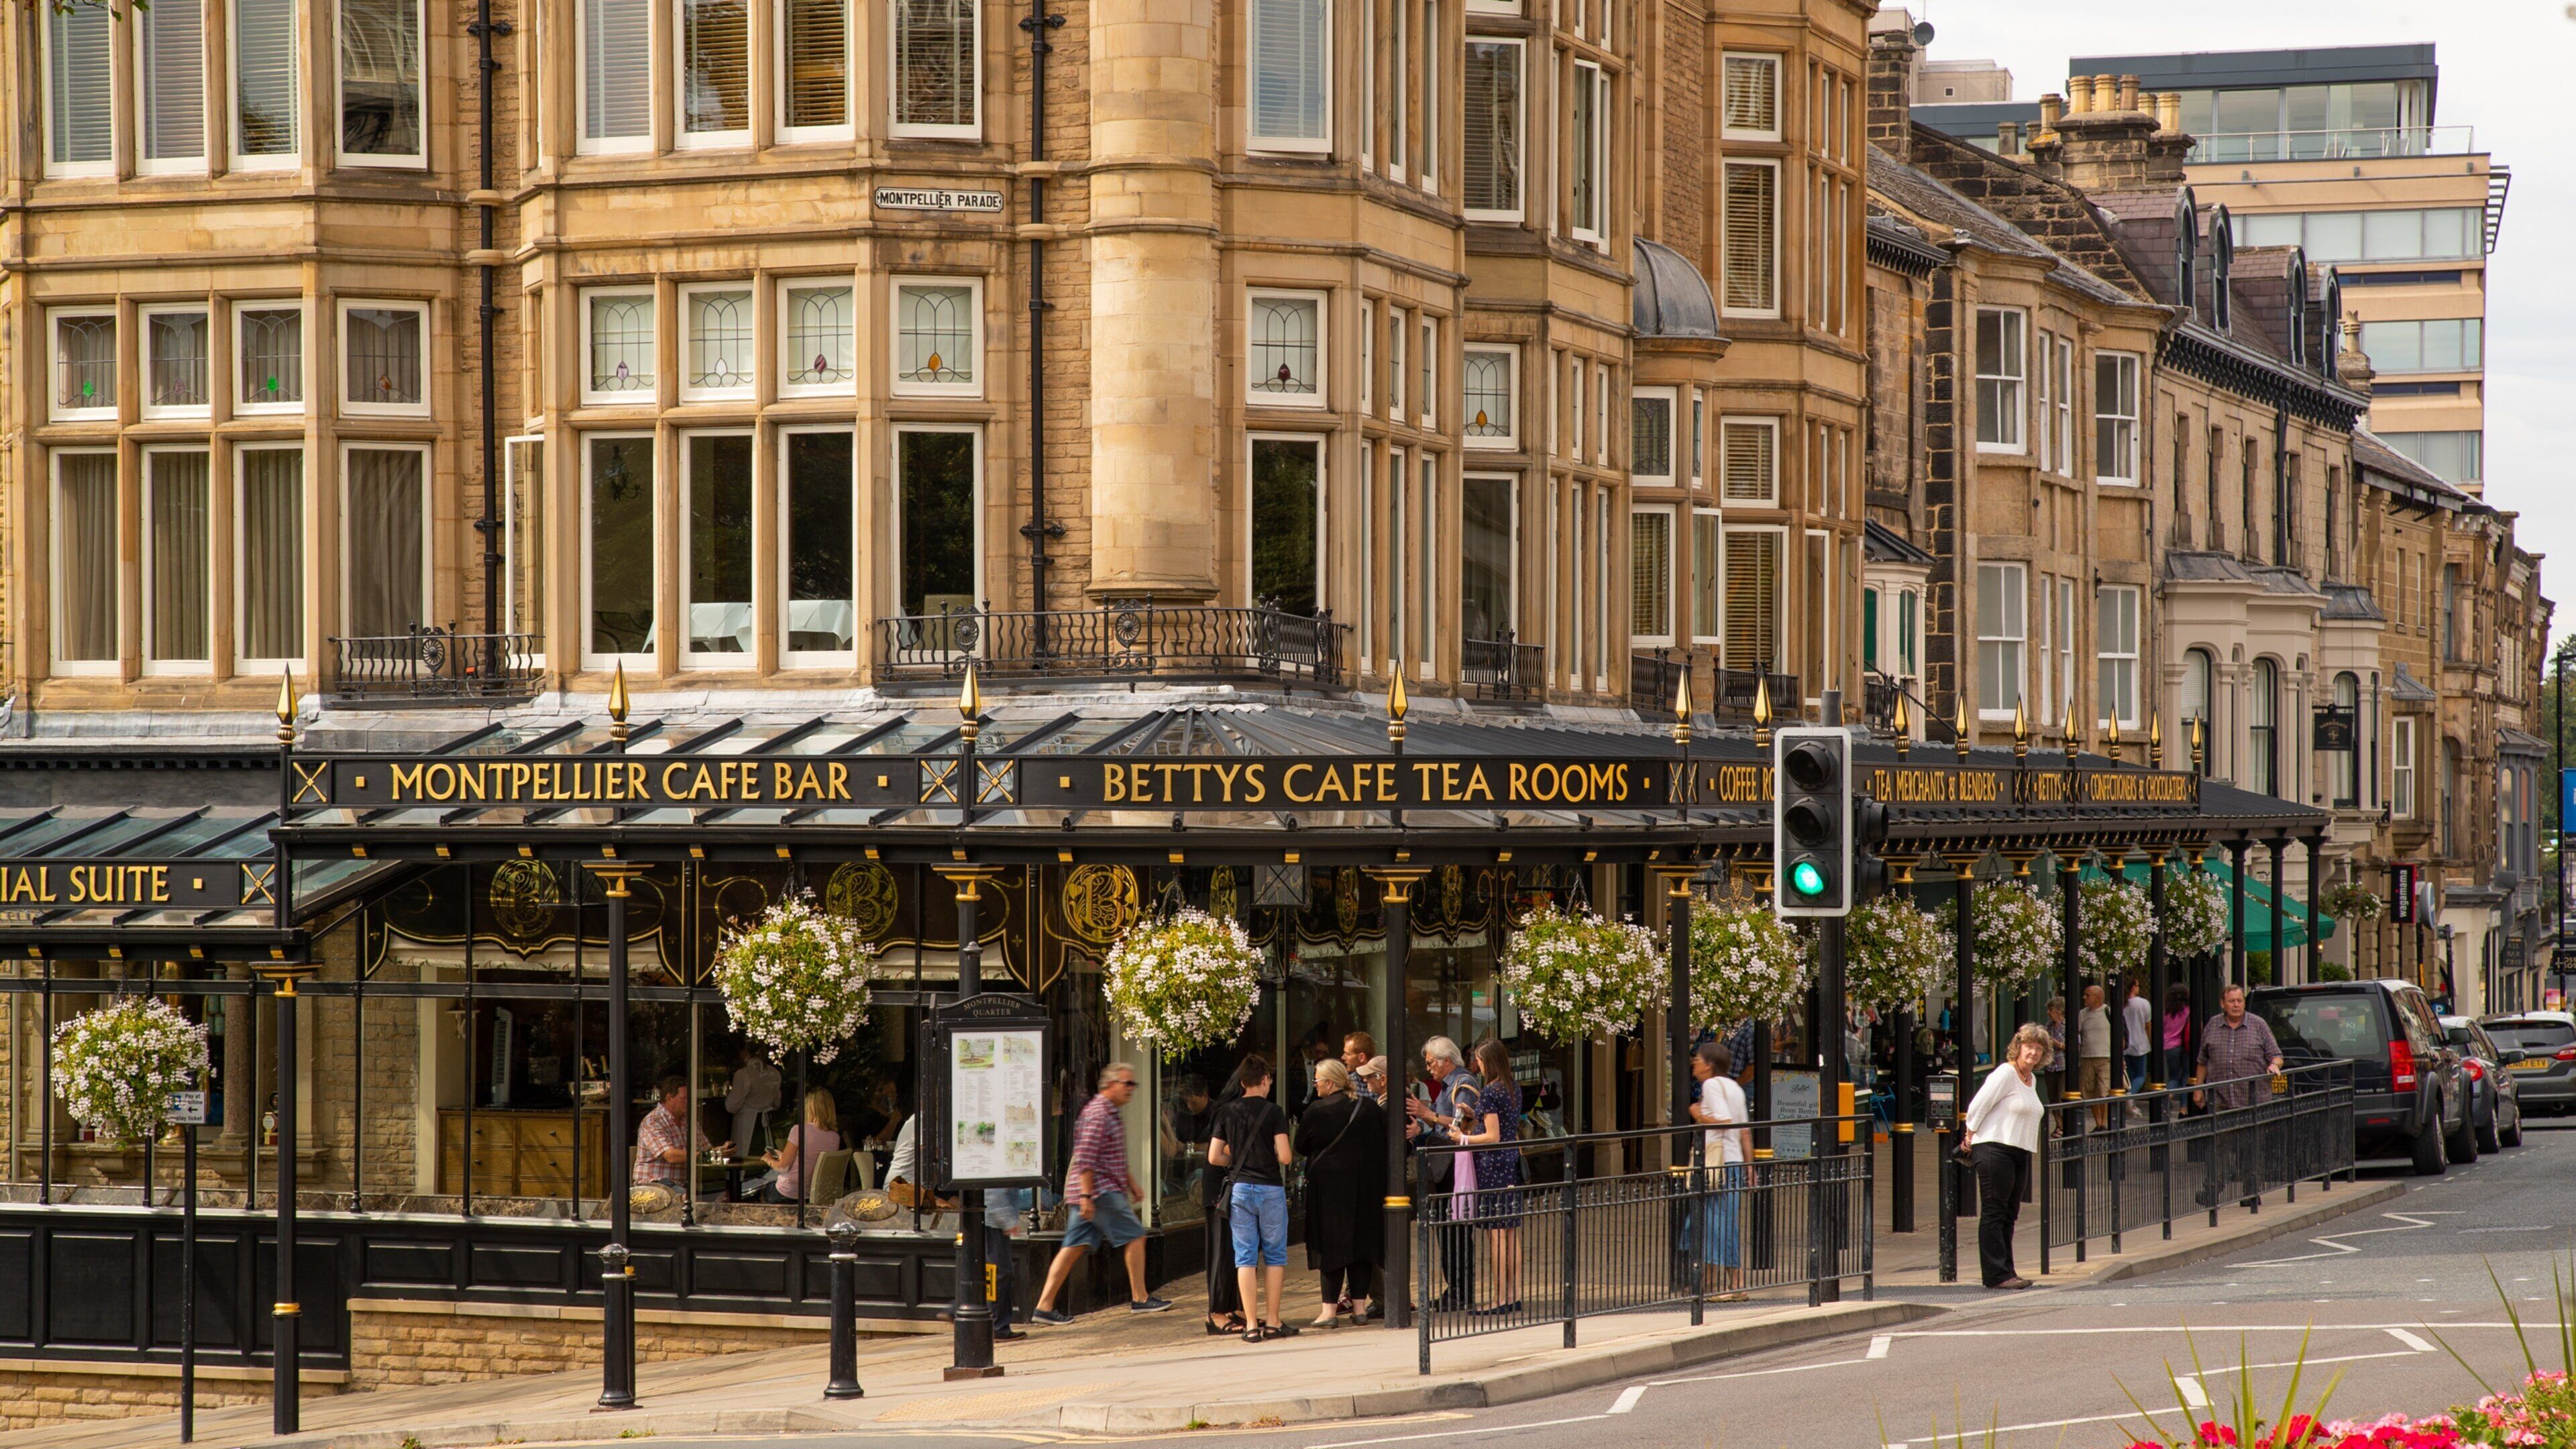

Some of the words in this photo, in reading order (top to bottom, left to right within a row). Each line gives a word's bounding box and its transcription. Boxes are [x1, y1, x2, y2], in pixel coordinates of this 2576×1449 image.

[879, 192, 951, 206] MONTPELLIER
[958, 194, 999, 207] PARADE
[391, 763, 650, 800] MONTPELLIER
[663, 762, 760, 799] CAFE
[774, 763, 851, 799] BAR
[1104, 764, 1265, 802] BETTYS
[1283, 764, 1397, 802] CAFE
[1413, 763, 1494, 800] TEA
[1510, 763, 1627, 802] ROOMS
[1720, 766, 1757, 801] COFFEE
[1875, 770, 1892, 801] TEA
[1896, 771, 1945, 802] MERCHANTS
[1948, 776, 1955, 801] &
[1960, 771, 1996, 801] BLENDERS
[2038, 773, 2061, 801] BETTYS
[2090, 773, 2137, 801] CONFECTIONERS
[2147, 775, 2187, 801] CHOCOLATIERS
[69, 865, 170, 902] SUITE
[2400, 869, 2409, 918] wagamama
[963, 997, 1020, 1010] MONTPELLIER
[973, 1009, 1012, 1018] QUARTER
[629, 1191, 657, 1207] Bettys
[855, 1198, 883, 1214] Bettys
